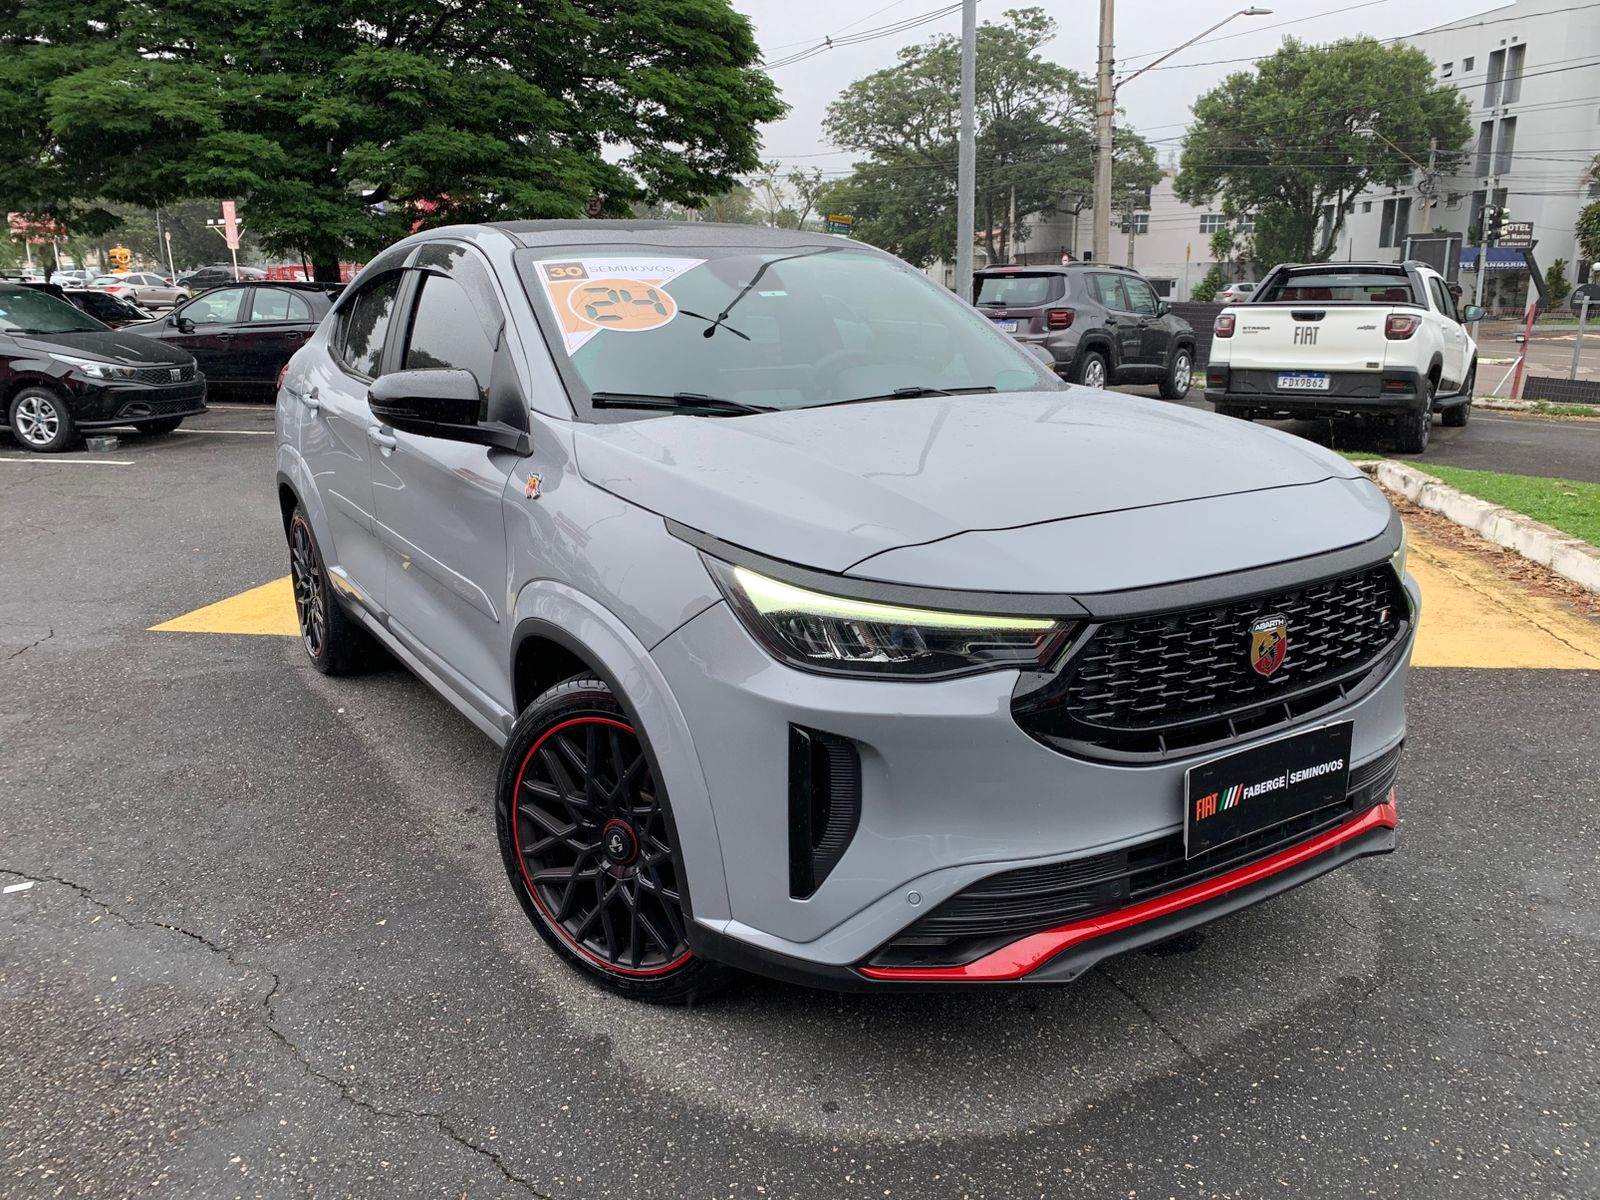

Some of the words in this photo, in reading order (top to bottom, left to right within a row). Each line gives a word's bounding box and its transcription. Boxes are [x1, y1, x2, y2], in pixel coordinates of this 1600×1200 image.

[549, 266, 583, 278] 30
[588, 264, 676, 273] SEMINOVOS
[583, 287, 667, 321] 24
[1293, 326, 1320, 345] FIAT
[1282, 377, 1324, 388] FDX9B62
[1255, 619, 1284, 631] ABARTH
[1196, 793, 1219, 822] FIAT
[1243, 776, 1286, 800] FABERGE
[1289, 758, 1344, 784] SEMINOVOS
